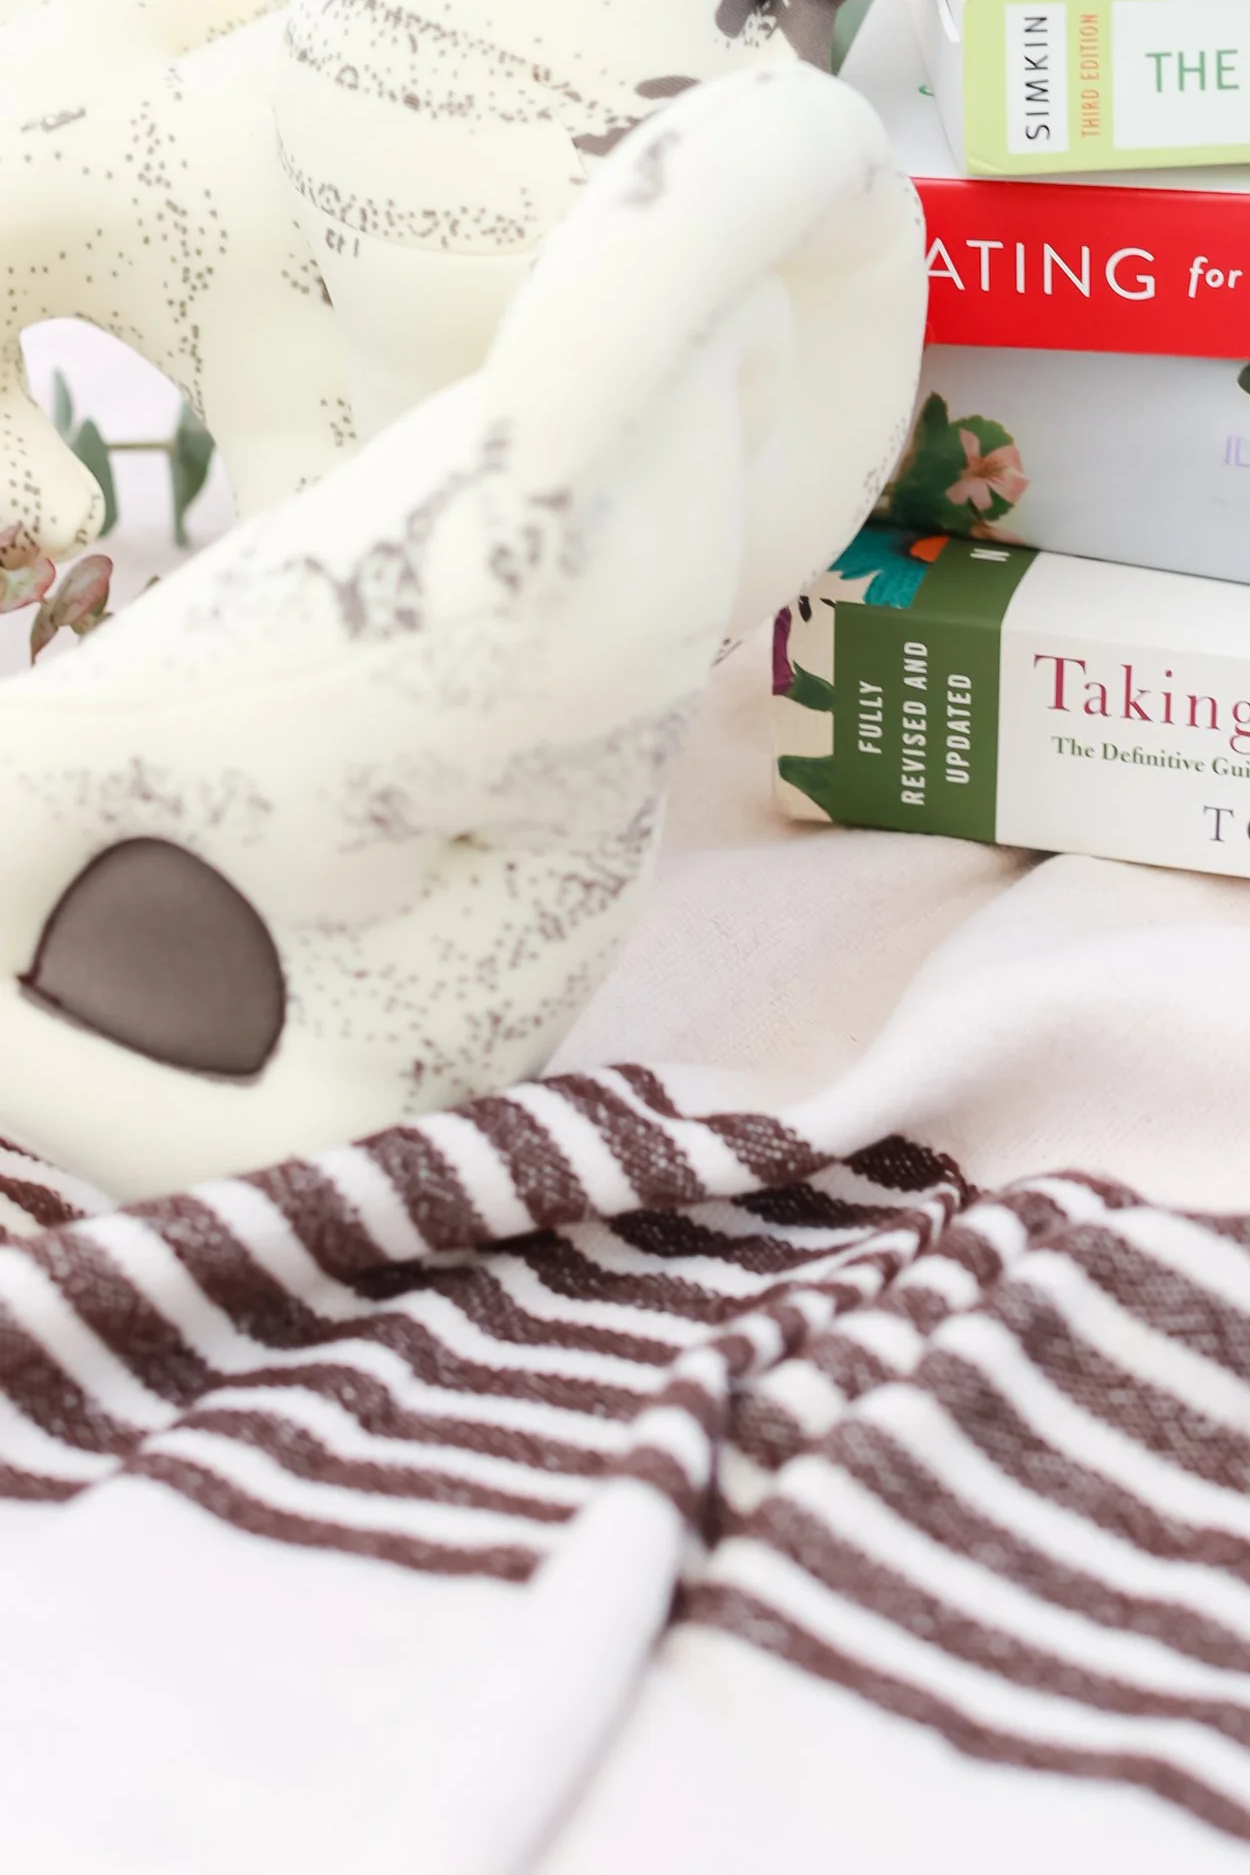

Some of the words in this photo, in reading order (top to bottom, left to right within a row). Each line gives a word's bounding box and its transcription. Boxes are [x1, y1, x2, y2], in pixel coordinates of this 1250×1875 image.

[1023, 15, 1052, 141] SIMKIN
[1080, 13, 1099, 82] EDITION
[1145, 49, 1241, 94] THE
[1081, 87, 1100, 138] THIRD
[926, 237, 1157, 301] ATING
[1188, 255, 1243, 299] for
[903, 640, 928, 691] AND
[858, 680, 883, 755] FULLY
[945, 673, 972, 785] UPDATED
[901, 700, 927, 806] REVISED
[1051, 735, 1095, 760] The
[1102, 742, 1205, 774] Definitive
